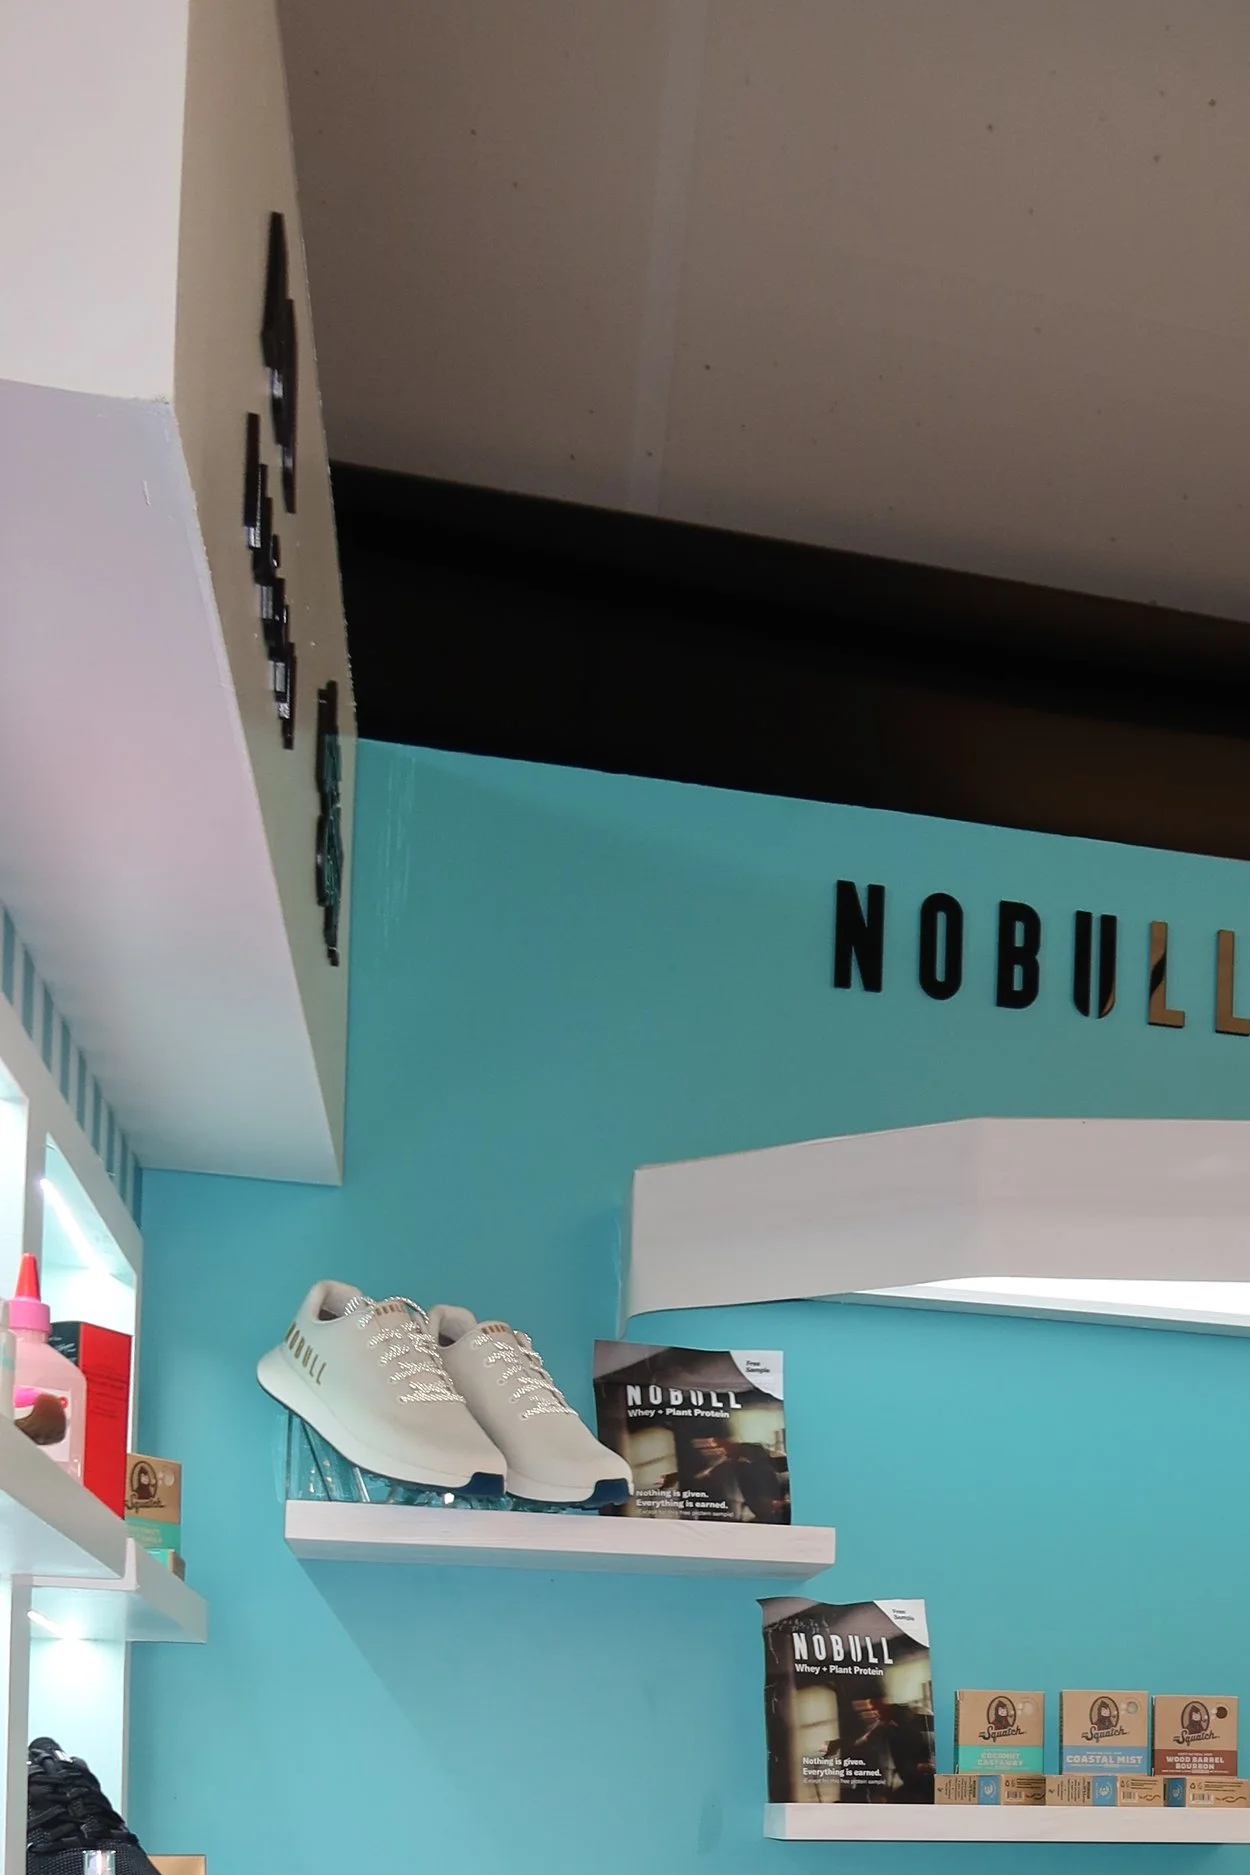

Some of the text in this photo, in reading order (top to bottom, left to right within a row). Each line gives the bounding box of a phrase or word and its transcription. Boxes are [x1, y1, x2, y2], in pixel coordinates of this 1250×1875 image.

[626, 1384, 743, 1409] NOBULL
[628, 1408, 656, 1419] Whey
[666, 1407, 693, 1417] Plant
[694, 1408, 730, 1419] Protein
[636, 1489, 671, 1498] Nothing
[682, 1490, 709, 1499] given.
[636, 1499, 685, 1509] Everything
[695, 1500, 729, 1509] earned.
[792, 1632, 894, 1665] NOBULL
[795, 1663, 821, 1675] Whey
[829, 1664, 853, 1675] Plant
[854, 1666, 884, 1676] Protein
[979, 1725, 1024, 1743] Squatch
[1081, 1725, 1128, 1743] Squatch
[1173, 1729, 1218, 1746] Squatch
[802, 1757, 834, 1767] Nothing
[843, 1757, 866, 1767] given.
[1066, 1754, 1143, 1765] COASTAL MIST
[802, 1767, 845, 1778] Everything
[854, 1769, 882, 1777] earned.
